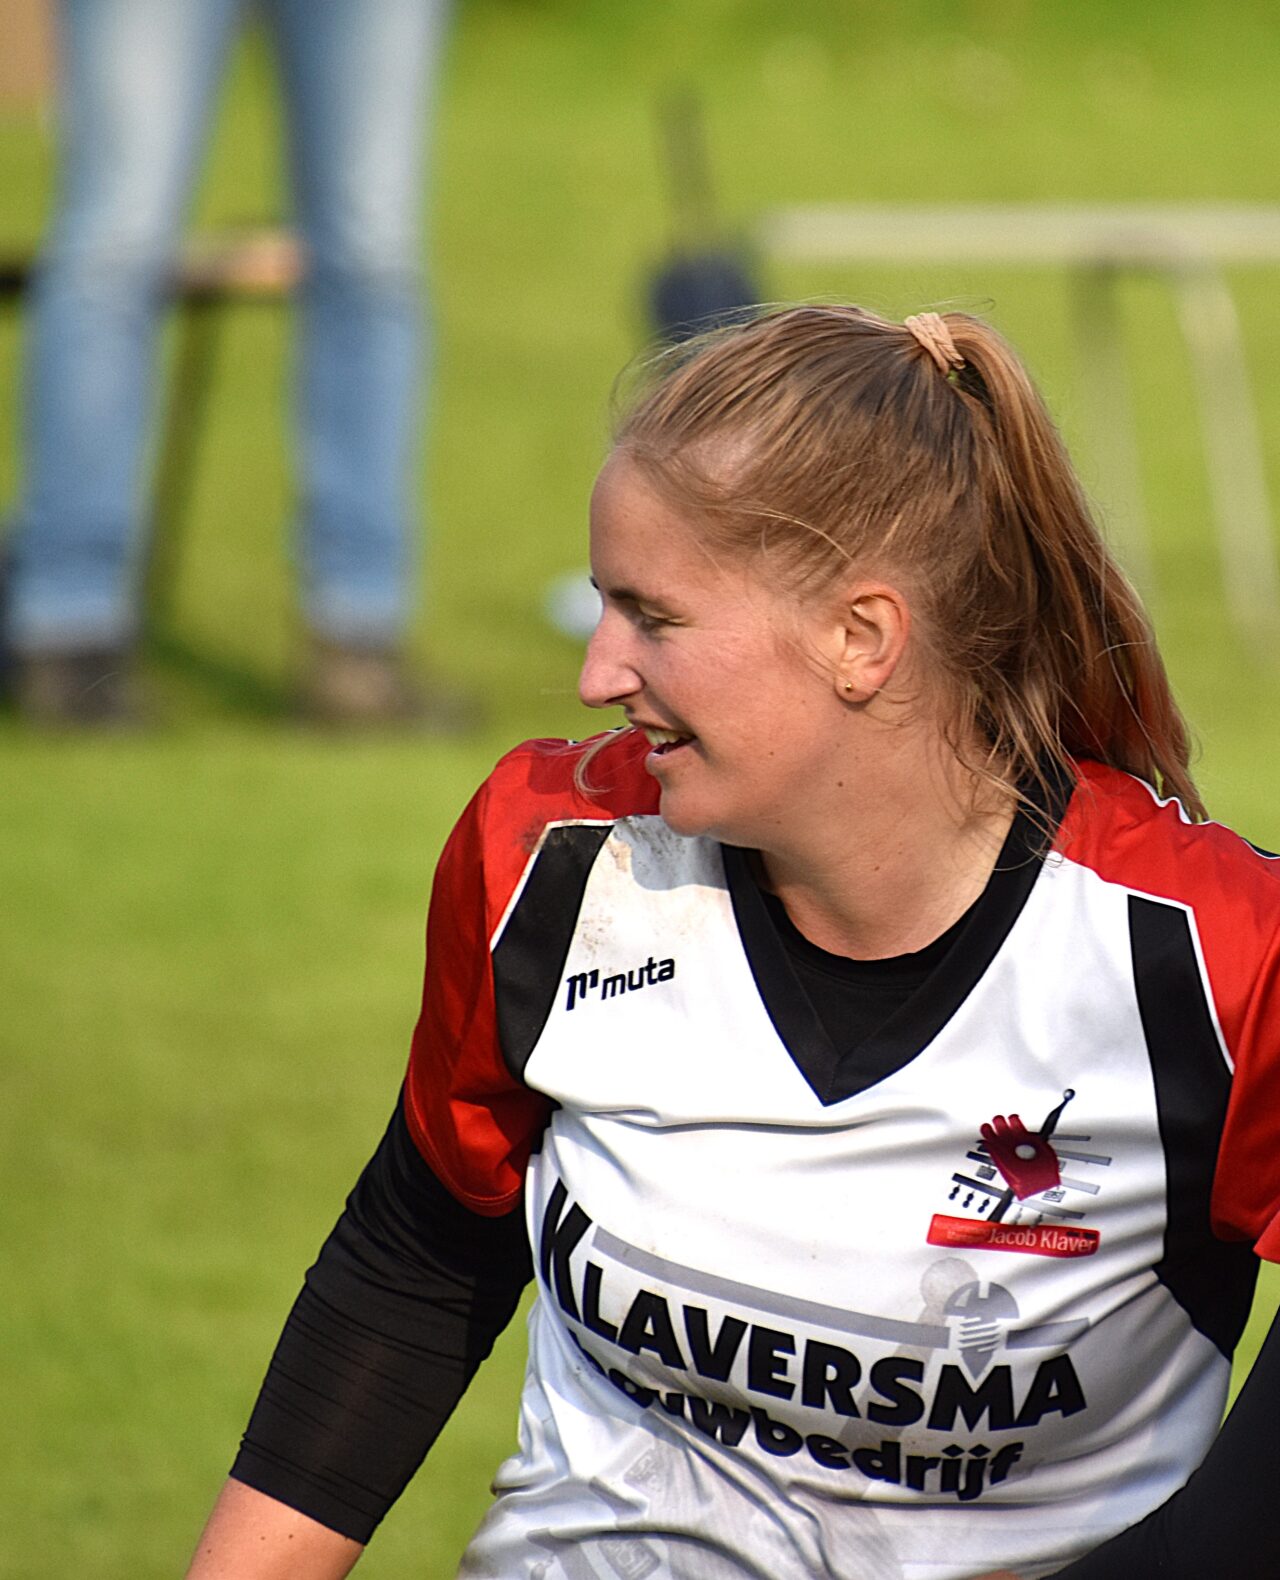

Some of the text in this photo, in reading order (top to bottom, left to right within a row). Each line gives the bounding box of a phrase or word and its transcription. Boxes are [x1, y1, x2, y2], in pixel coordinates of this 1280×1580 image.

[601, 957, 675, 1000] muta
[988, 1228, 1037, 1246] Jacob
[1040, 1230, 1096, 1251] Klaver
[541, 1178, 1087, 1432] KLAVERSMA
[567, 1328, 1024, 1499] ouwbedrijf
